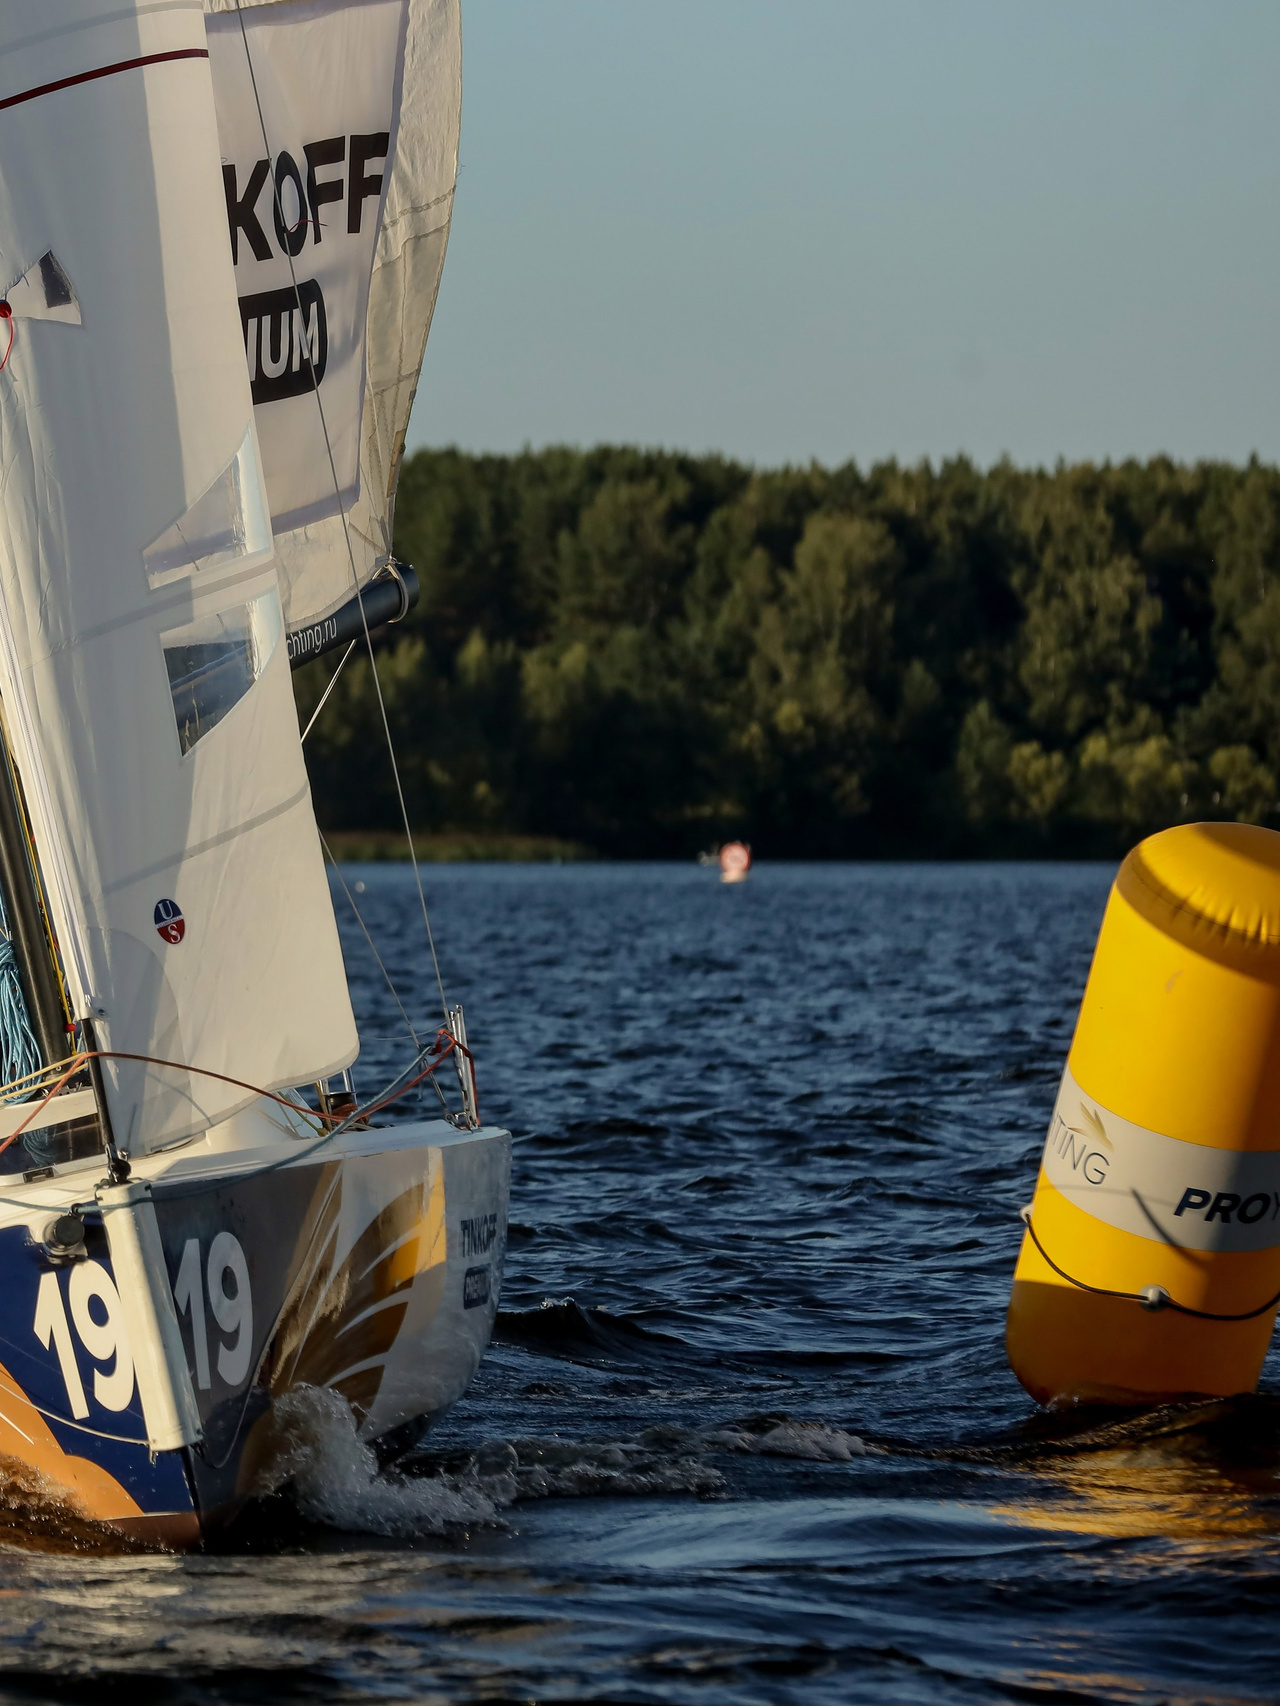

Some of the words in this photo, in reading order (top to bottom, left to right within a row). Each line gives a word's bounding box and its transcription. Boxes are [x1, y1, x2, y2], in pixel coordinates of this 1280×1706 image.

[221, 131, 390, 266] KOFF
[33, 1259, 135, 1420] 19
[173, 1231, 253, 1390] 19
